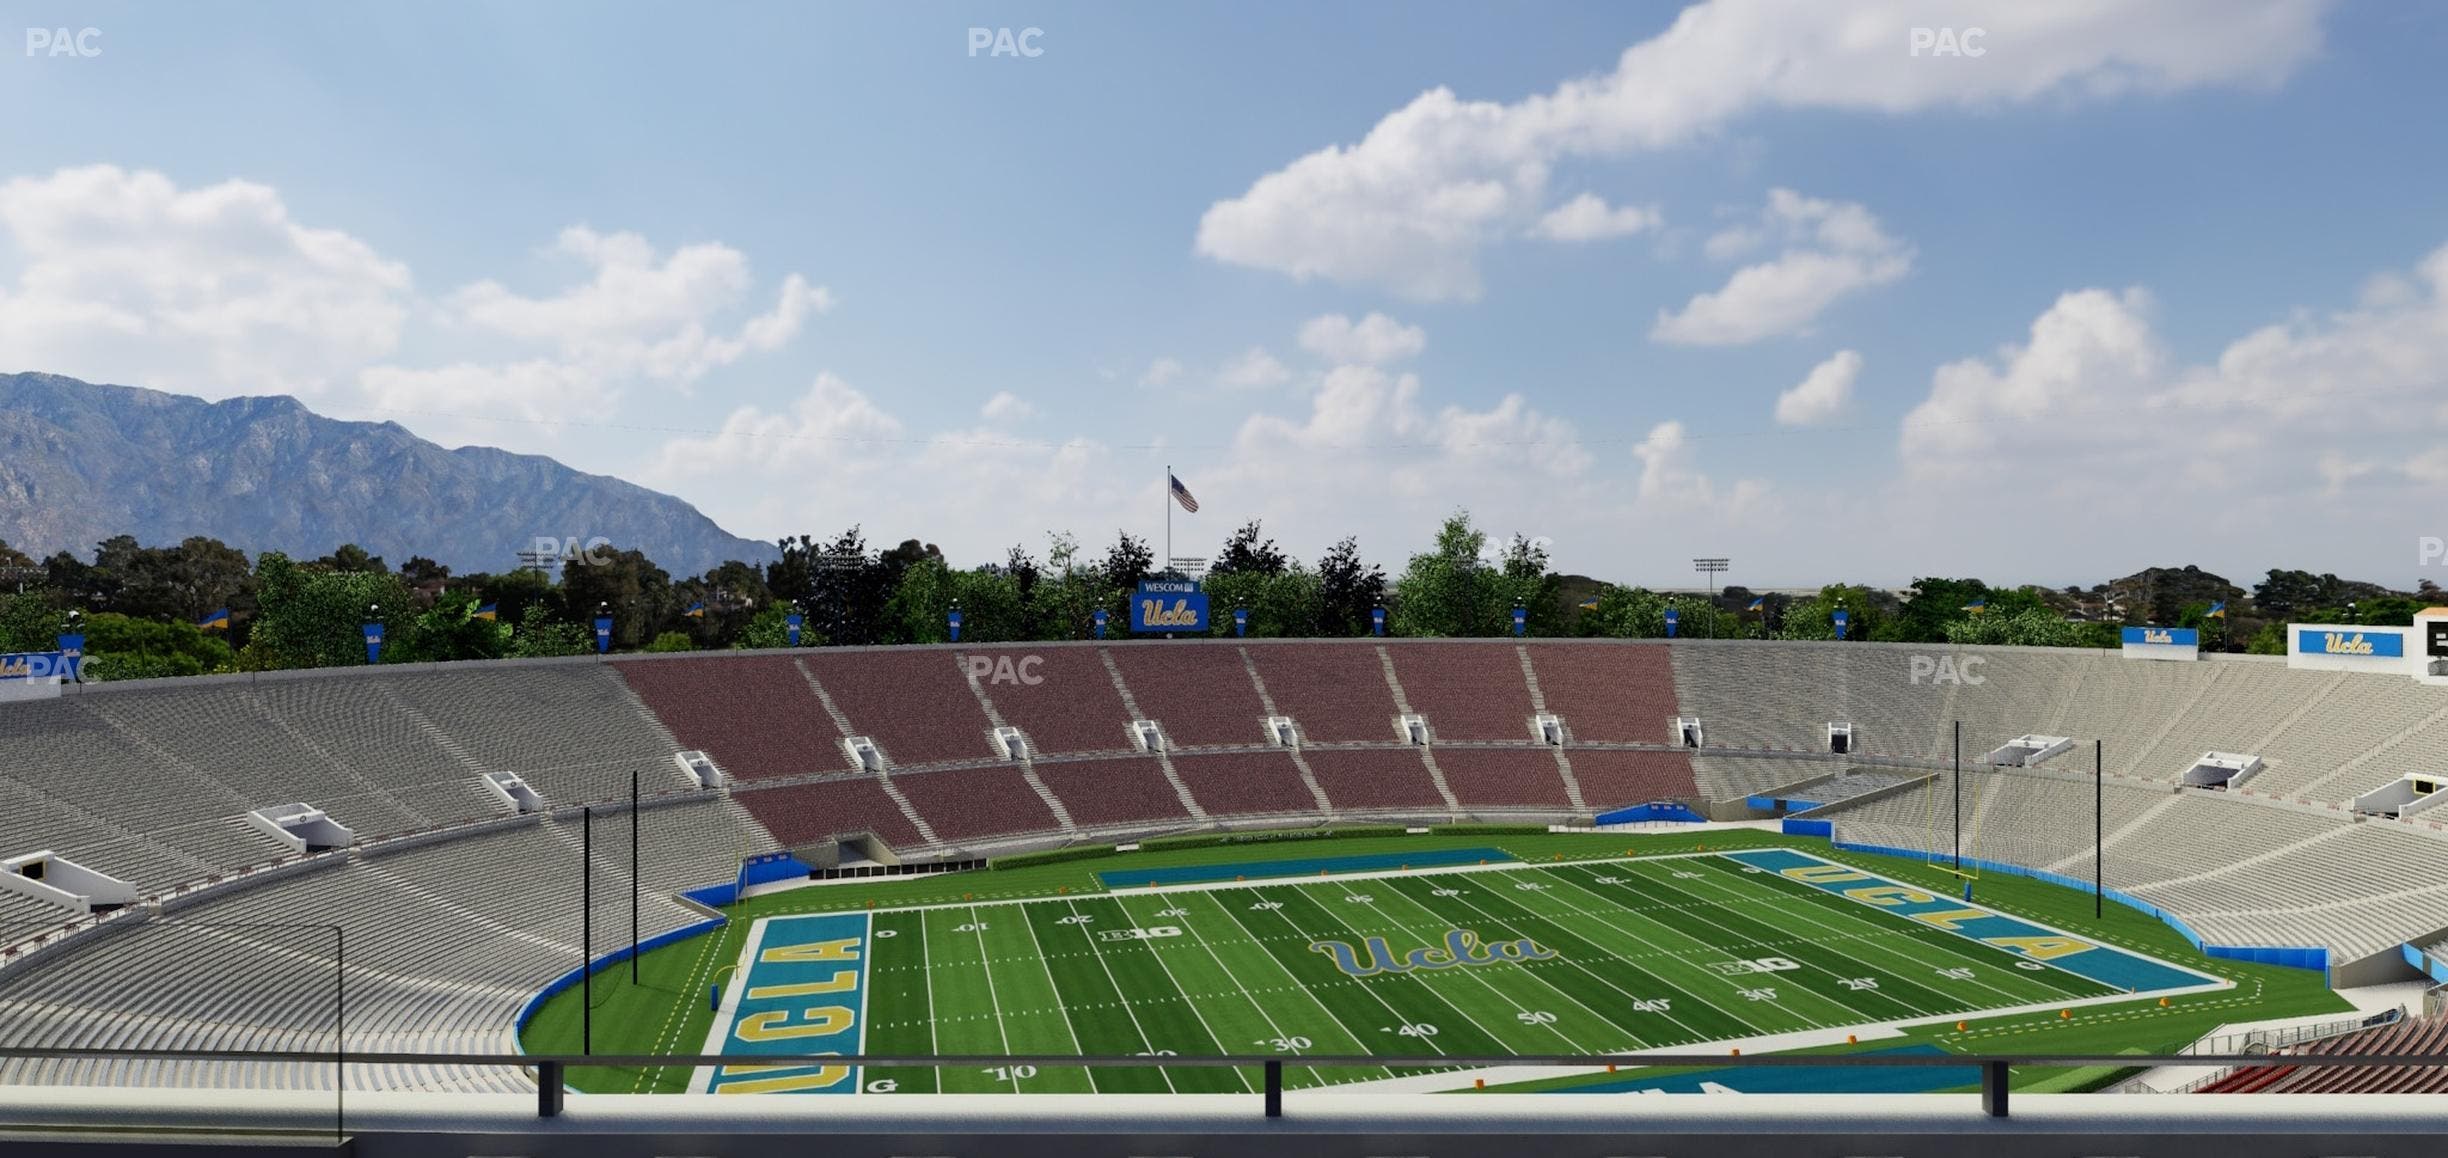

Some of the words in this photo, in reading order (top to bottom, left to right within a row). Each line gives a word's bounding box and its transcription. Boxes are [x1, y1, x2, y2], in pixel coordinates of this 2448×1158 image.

[1145, 582, 1184, 593] WESCOM
[1142, 599, 1198, 626] Ucla
[2325, 633, 2374, 655] Ucla
[1308, 929, 1559, 976] Ucla
[1517, 1011, 1557, 1025] 50
[1398, 1023, 1439, 1037] 40
[1269, 1036, 1312, 1052] 30
[993, 1064, 1037, 1082] 10
[867, 1079, 898, 1093] G
